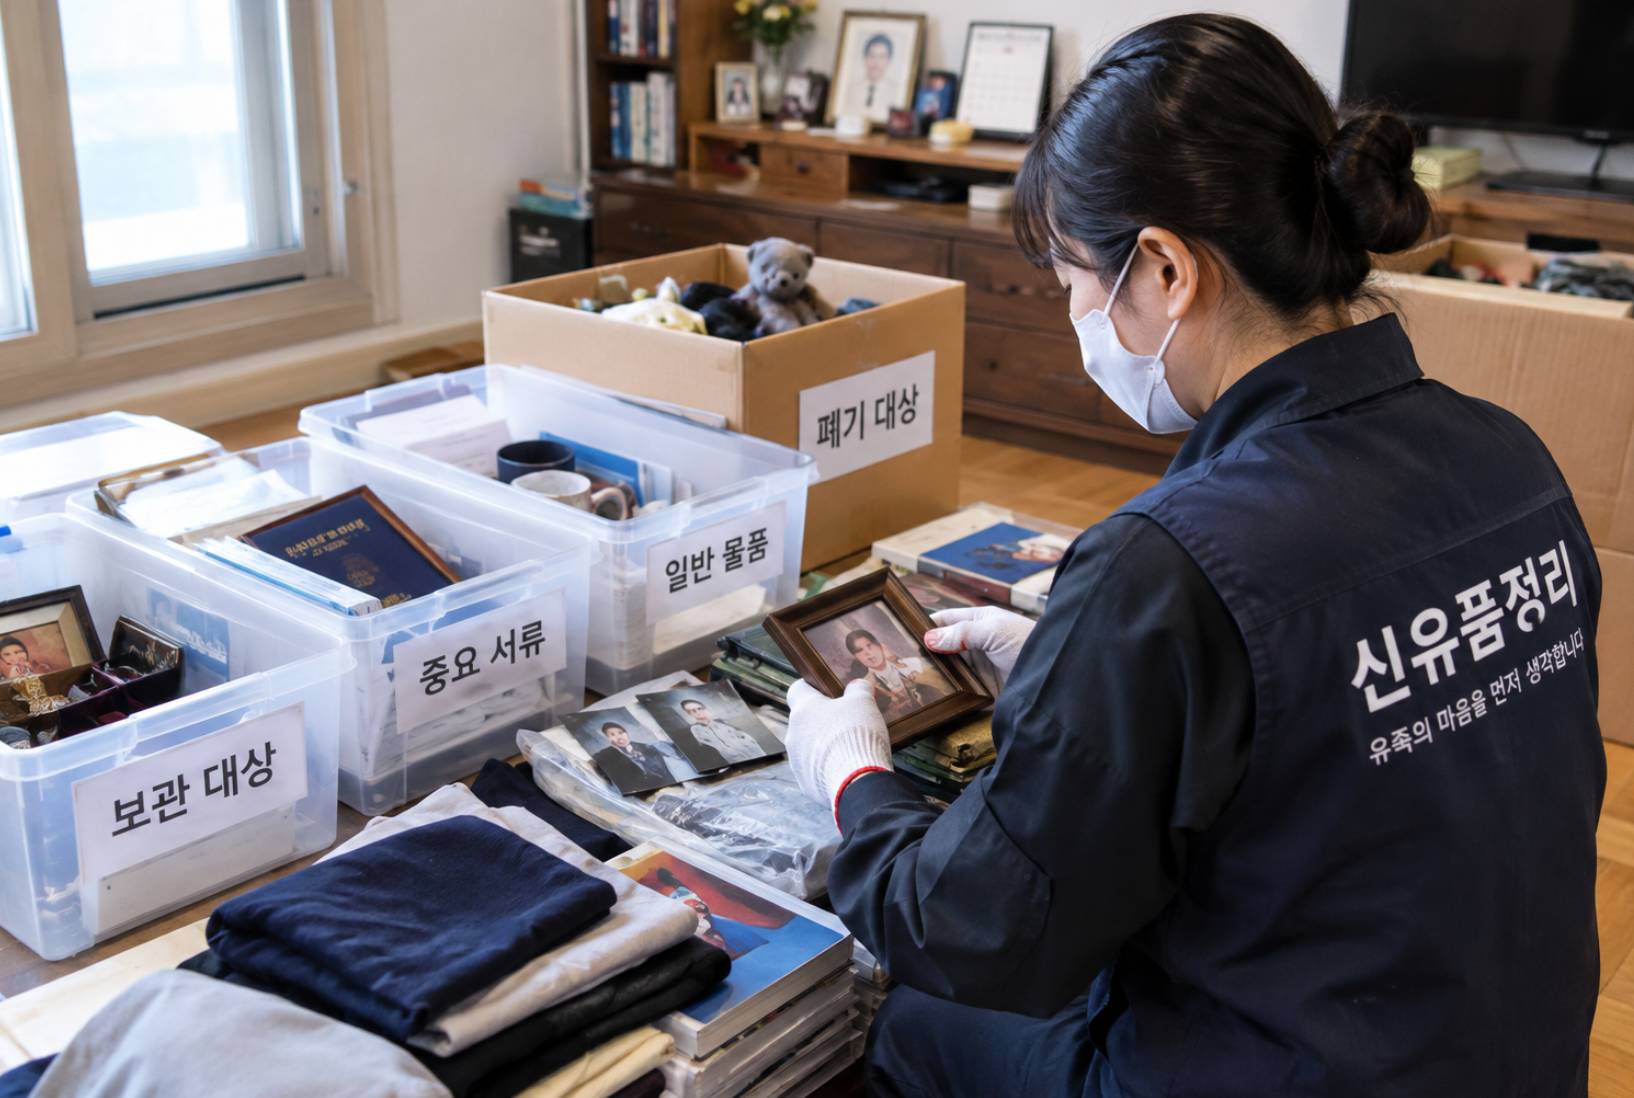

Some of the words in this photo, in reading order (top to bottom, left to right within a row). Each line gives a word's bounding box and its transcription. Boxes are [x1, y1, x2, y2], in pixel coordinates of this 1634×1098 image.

[816, 401, 865, 448] 폐기
[874, 384, 919, 430] 대상
[665, 546, 715, 593] 일반
[722, 528, 768, 573] 물품
[419, 646, 480, 695] 중요
[490, 620, 545, 664] 서류
[1351, 540, 1577, 713] 신유품정리
[1369, 717, 1433, 766] 유족의
[1436, 689, 1487, 732] 마음을
[1489, 668, 1522, 706] 먼저
[1525, 627, 1584, 685] 생각합니다
[112, 773, 190, 837] 보관
[203, 741, 276, 798] 대상
